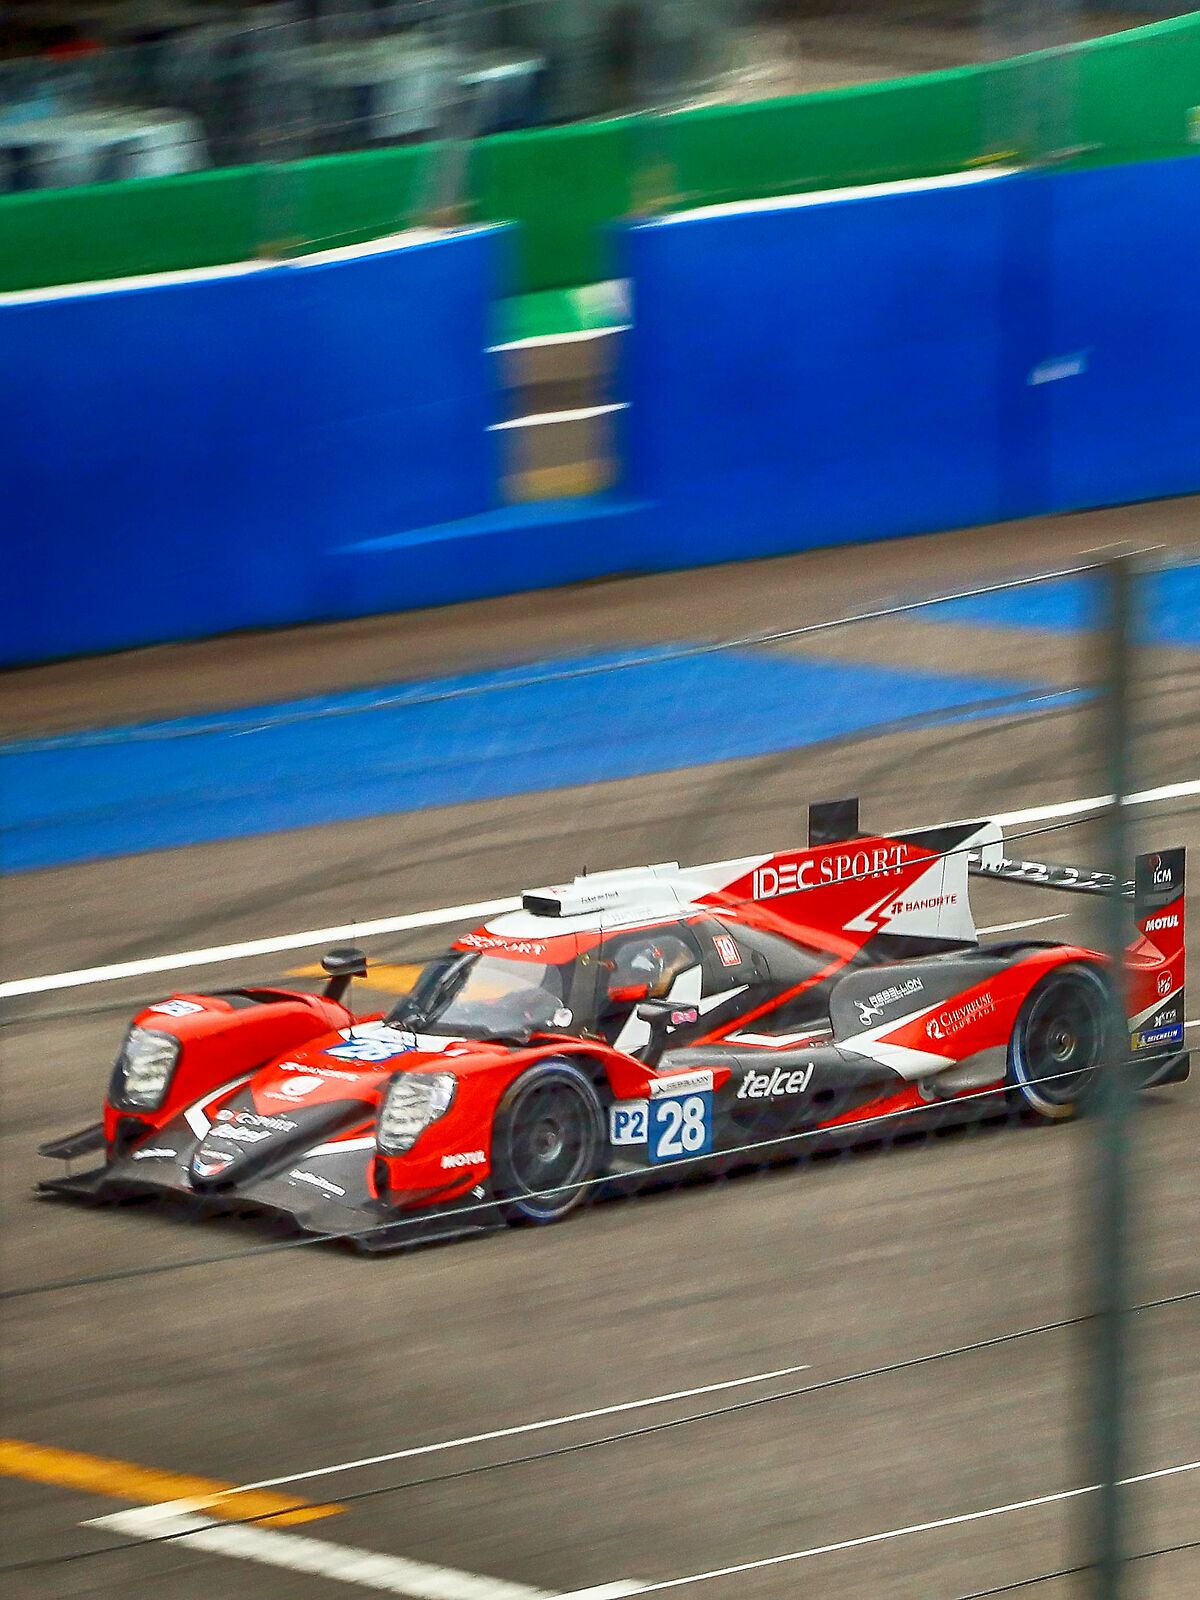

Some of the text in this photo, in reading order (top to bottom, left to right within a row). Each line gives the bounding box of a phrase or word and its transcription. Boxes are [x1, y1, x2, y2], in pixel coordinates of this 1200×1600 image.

[753, 845, 908, 900] IDEC SPORT
[905, 894, 957, 912] BANORTE
[1145, 914, 1179, 932] MOTUL
[868, 977, 923, 1006] REBELLION
[1147, 1029, 1178, 1043] MICHELIN
[737, 1062, 814, 1100] telcel
[615, 1111, 645, 1139] P2
[656, 1097, 706, 1158] 28
[441, 1149, 487, 1169] MOTUL
